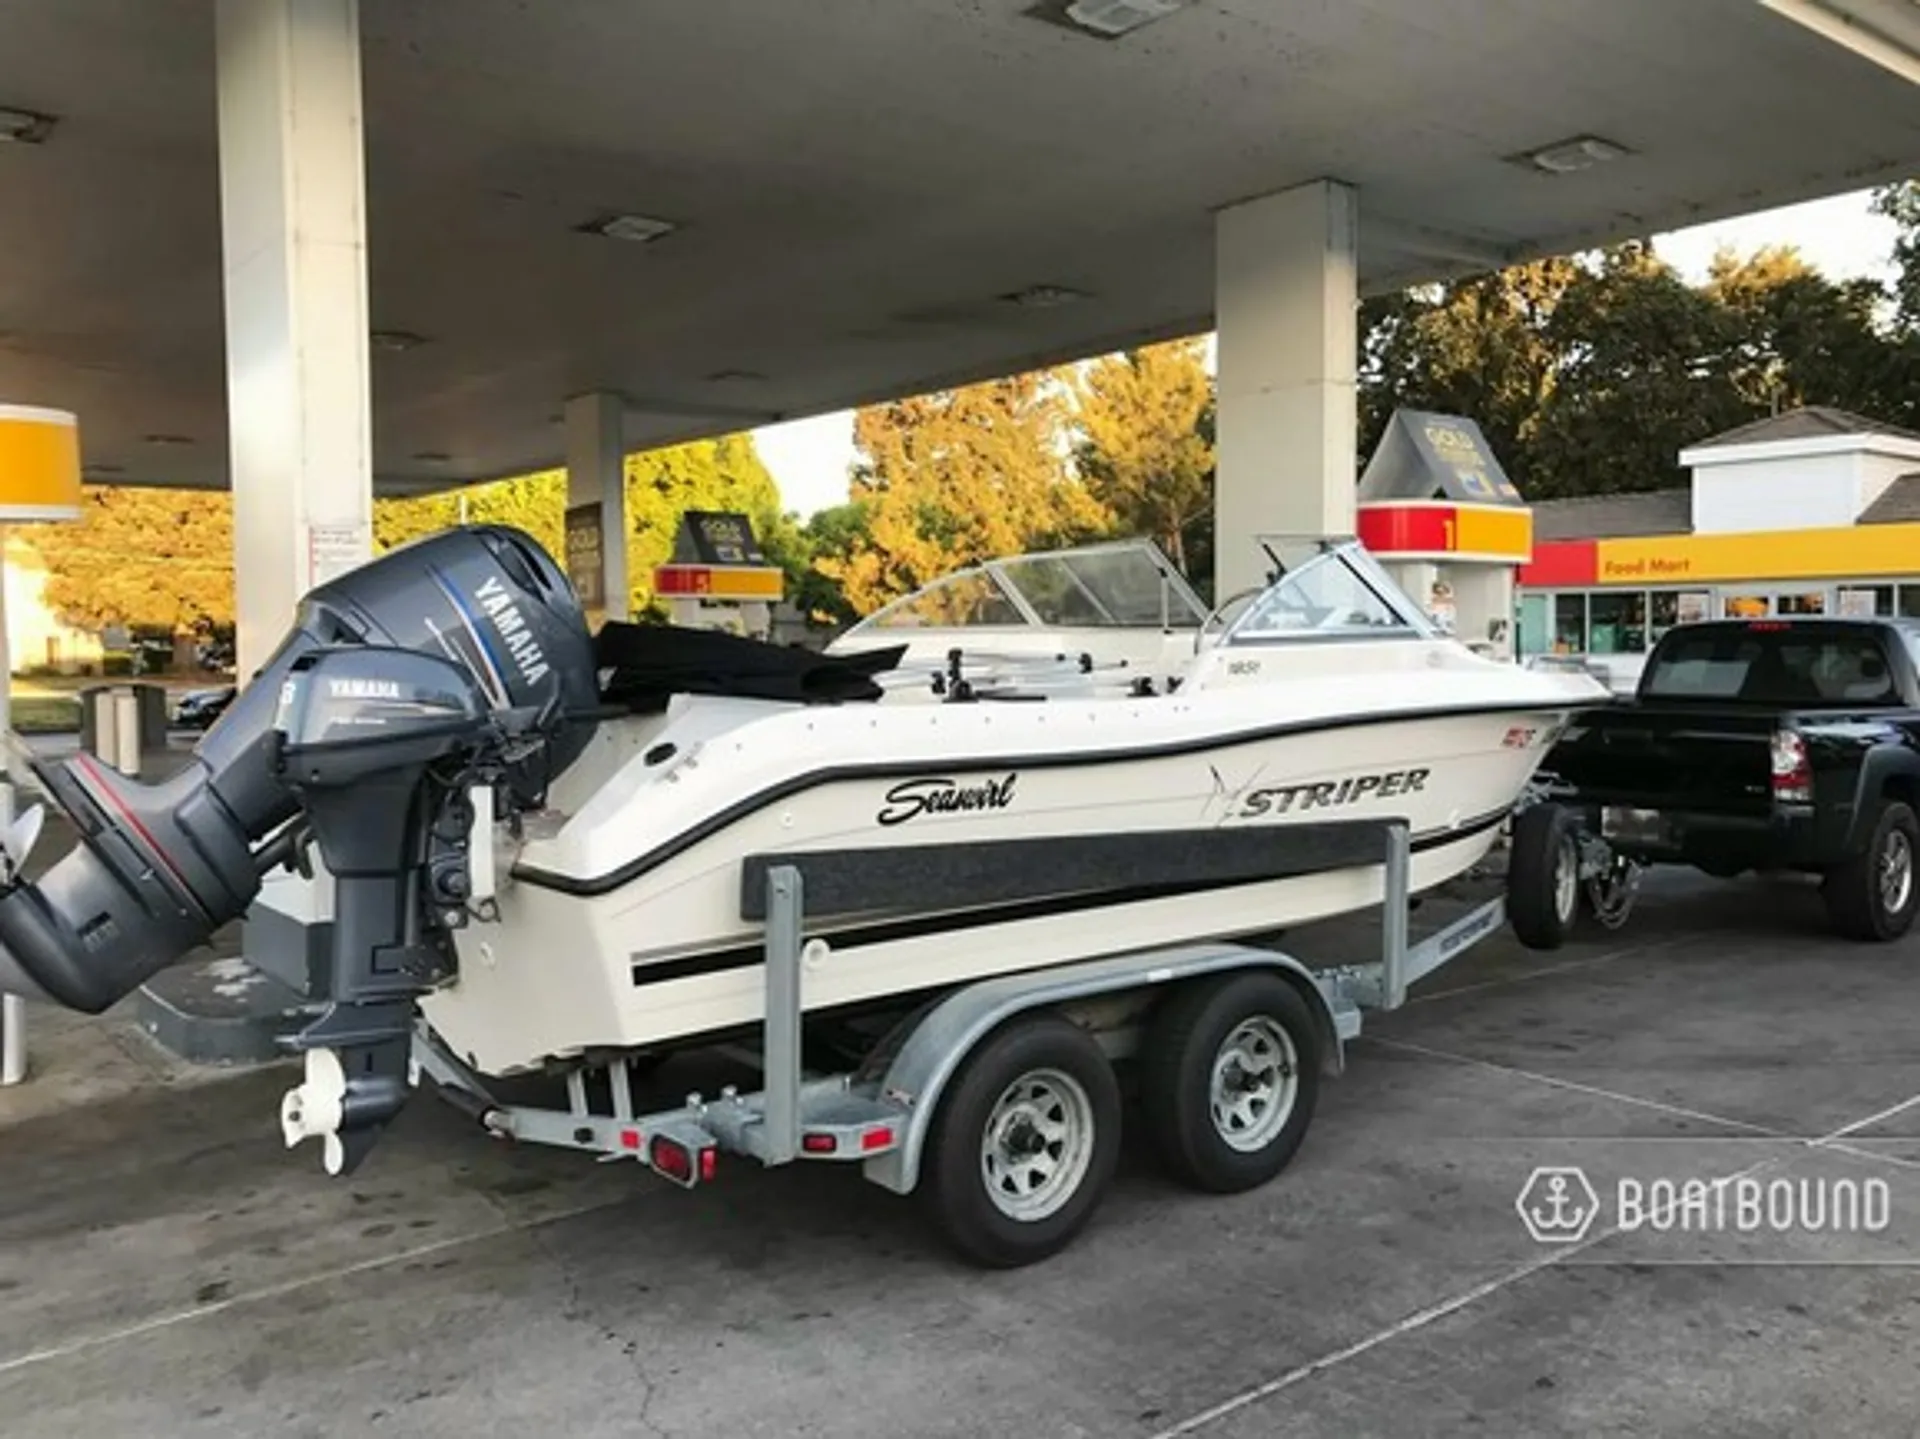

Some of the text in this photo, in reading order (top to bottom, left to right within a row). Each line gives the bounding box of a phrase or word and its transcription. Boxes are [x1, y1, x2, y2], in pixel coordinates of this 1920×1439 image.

[1605, 558, 1690, 575] Food Mart
[474, 576, 550, 687] YAMAHA
[329, 679, 400, 698] YAMAHA
[1240, 768, 1430, 818] STRIPER
